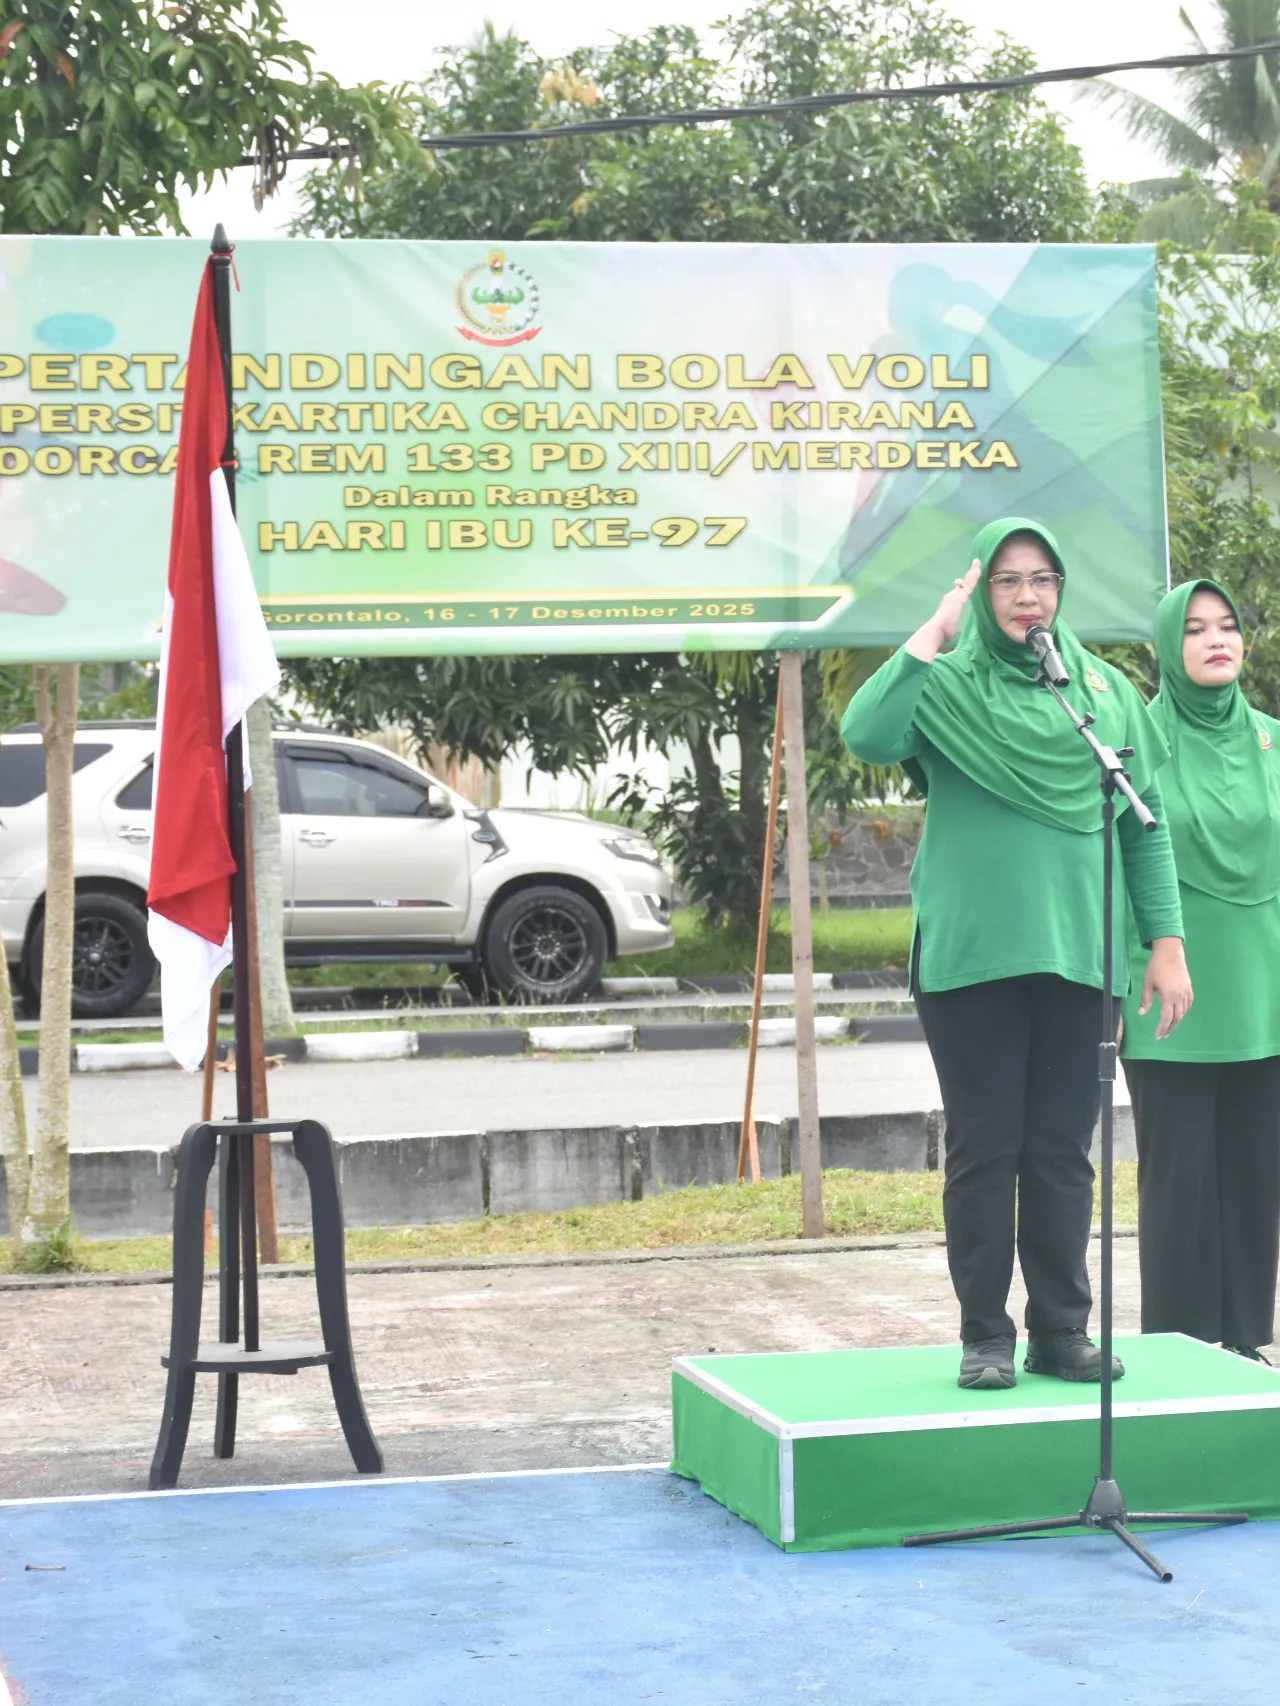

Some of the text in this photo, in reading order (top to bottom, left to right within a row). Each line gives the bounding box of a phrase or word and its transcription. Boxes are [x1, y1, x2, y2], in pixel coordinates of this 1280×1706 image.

[0, 353, 989, 391] PERTNDINGAN BOLA VOLI
[0, 401, 976, 433] PERSI KARTIKA CHANDRA KIRANA
[258, 443, 386, 474] REM
[407, 442, 513, 473] 133
[530, 442, 606, 472] PD
[618, 440, 1020, 477] XIII/MERDEKA
[343, 484, 638, 511] Dalam Rangka
[258, 516, 748, 552] HARI IBU KE-97
[423, 608, 456, 621] 16
[488, 607, 520, 620] 17
[531, 605, 679, 620] Desember
[688, 603, 757, 617] 2025
